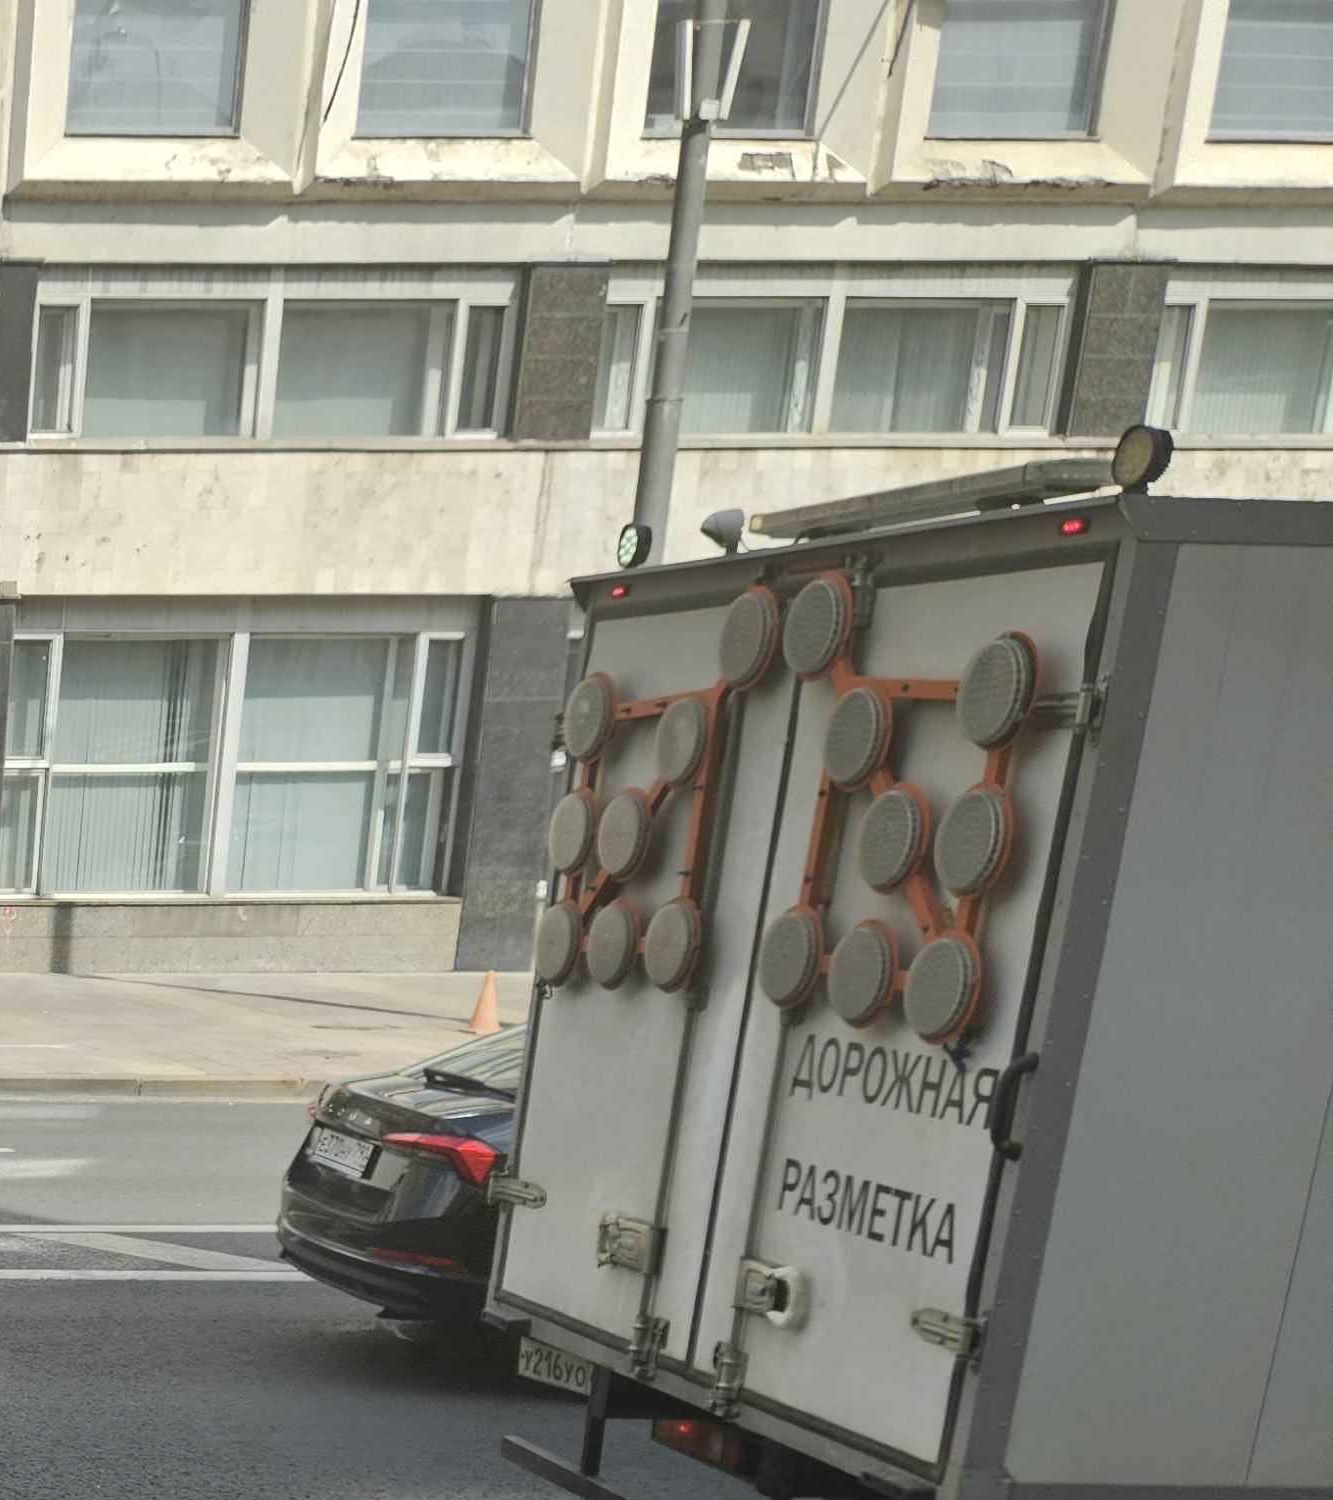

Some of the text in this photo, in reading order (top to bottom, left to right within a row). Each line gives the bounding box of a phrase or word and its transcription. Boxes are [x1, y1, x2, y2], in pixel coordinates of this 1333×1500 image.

[789, 1033, 1000, 1131] ДОРОЖНАЯ
[776, 1158, 956, 1265] РАЗМЕТКА
[523, 1346, 587, 1388] У216УО
